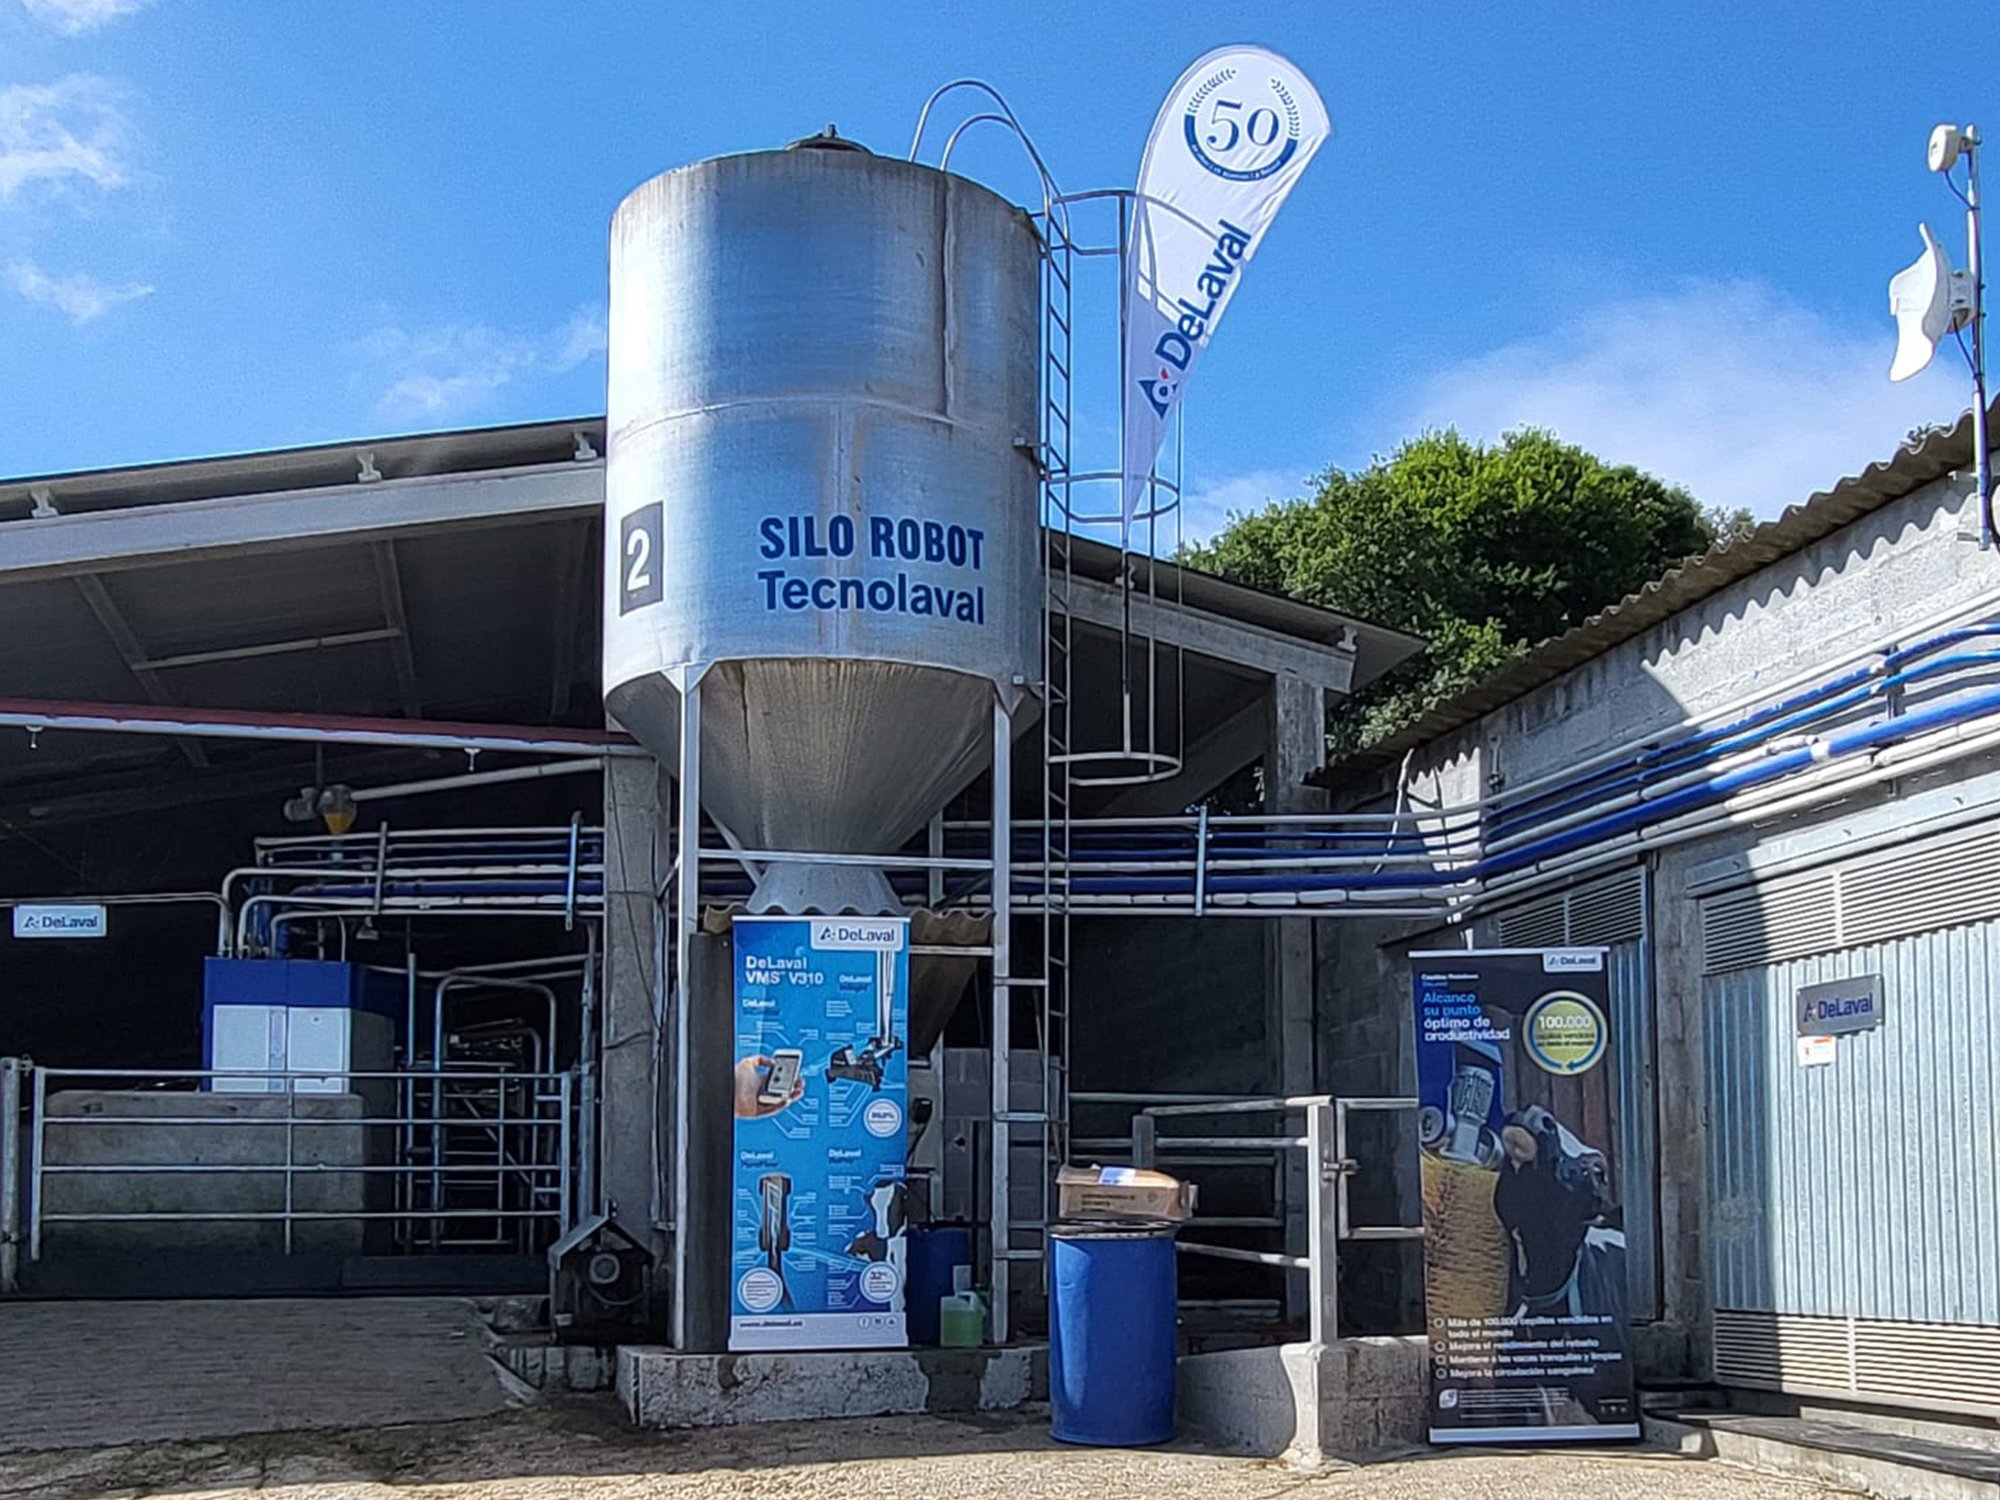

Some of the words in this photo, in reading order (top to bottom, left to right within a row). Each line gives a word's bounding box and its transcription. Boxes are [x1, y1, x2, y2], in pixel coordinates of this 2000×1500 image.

[1206, 99, 1280, 151] 50
[1154, 218, 1252, 371] DeLaval
[759, 515, 854, 559] SILO
[870, 516, 984, 570] ROBOT
[626, 528, 651, 592] 2
[757, 570, 985, 625] Tecnolaval
[42, 915, 98, 928] DeLaval
[838, 928, 895, 942] DeLaval
[745, 955, 808, 970] DeLaval
[1560, 955, 1597, 966] DeLaval
[788, 972, 825, 986] V310
[1423, 1006, 1440, 1016] su
[1442, 1004, 1482, 1018] punto
[1818, 991, 1874, 1020] DeLaval
[1423, 1016, 1471, 1031] óptimo
[1473, 1015, 1491, 1028] de
[1424, 1027, 1511, 1042] productividad
